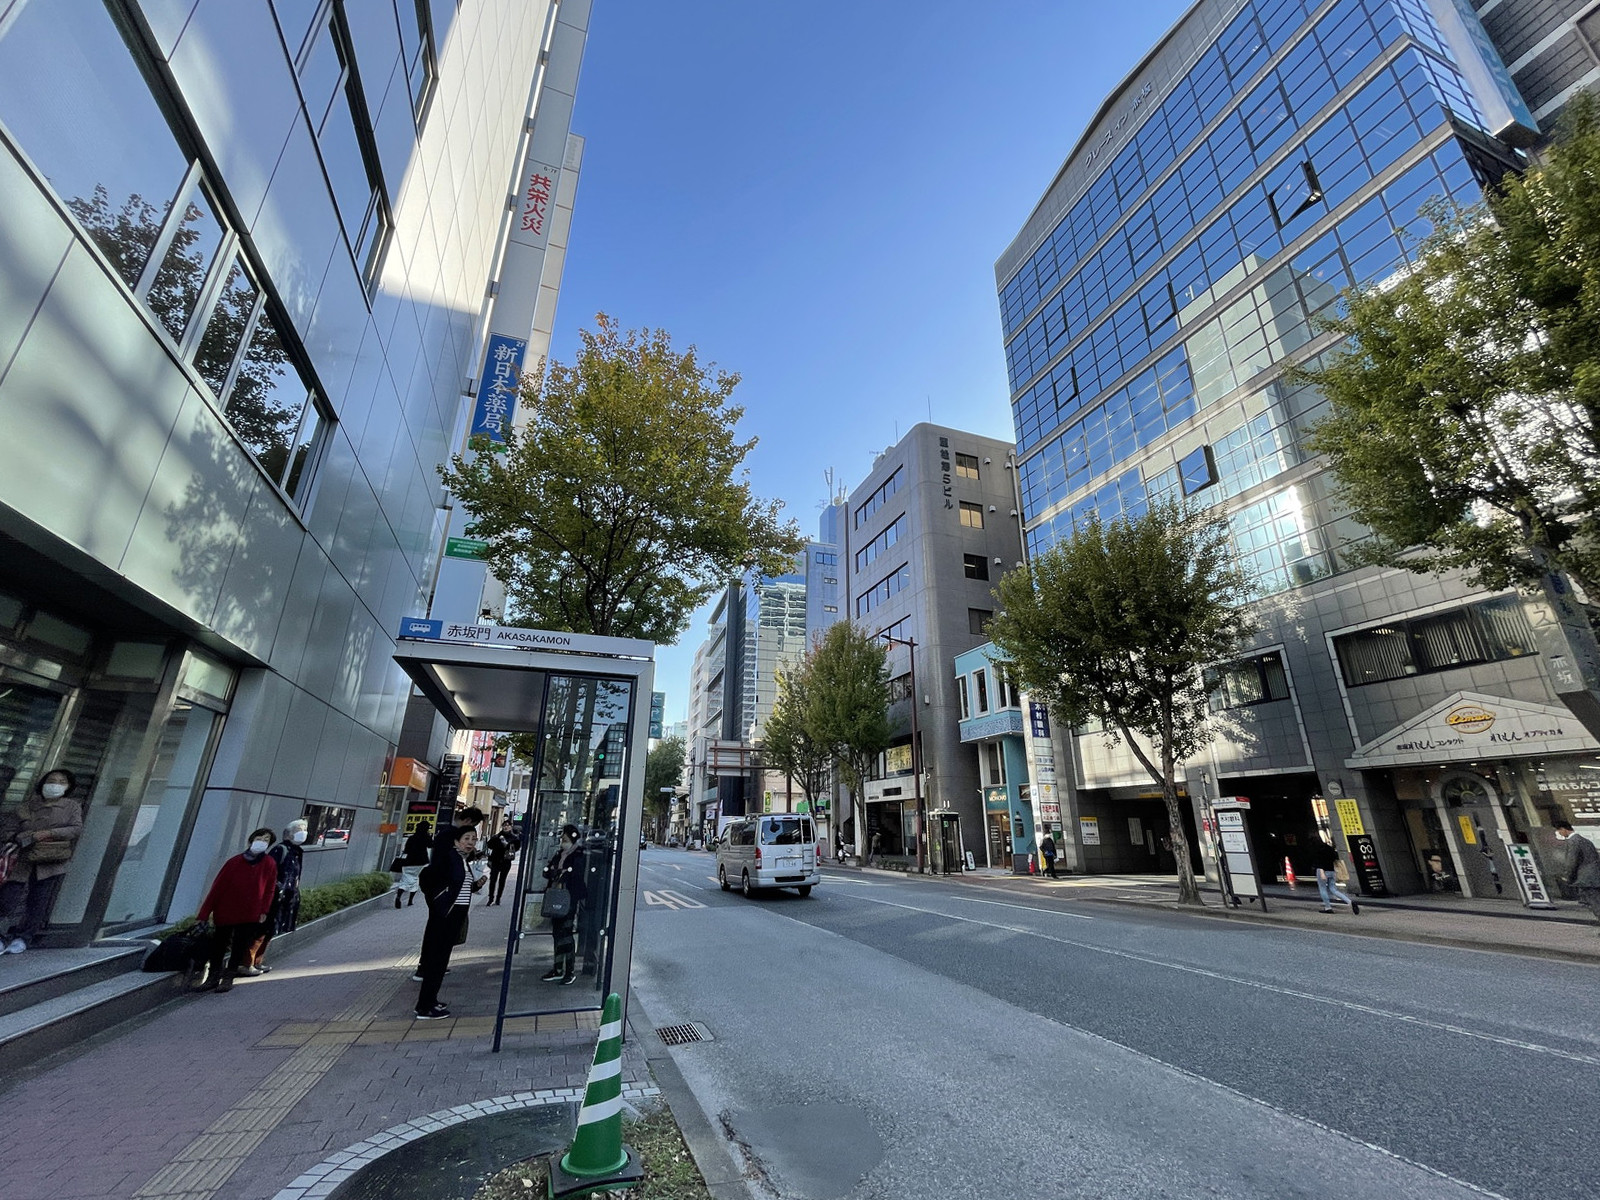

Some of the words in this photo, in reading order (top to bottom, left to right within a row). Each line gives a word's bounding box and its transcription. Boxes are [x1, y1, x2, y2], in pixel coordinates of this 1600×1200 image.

[521, 173, 552, 236] 共栄火災
[479, 343, 518, 434] 新日本薬局
[447, 624, 491, 640] 赤坂門
[496, 631, 571, 646] AKASAKAMON
[643, 889, 709, 911] 40
